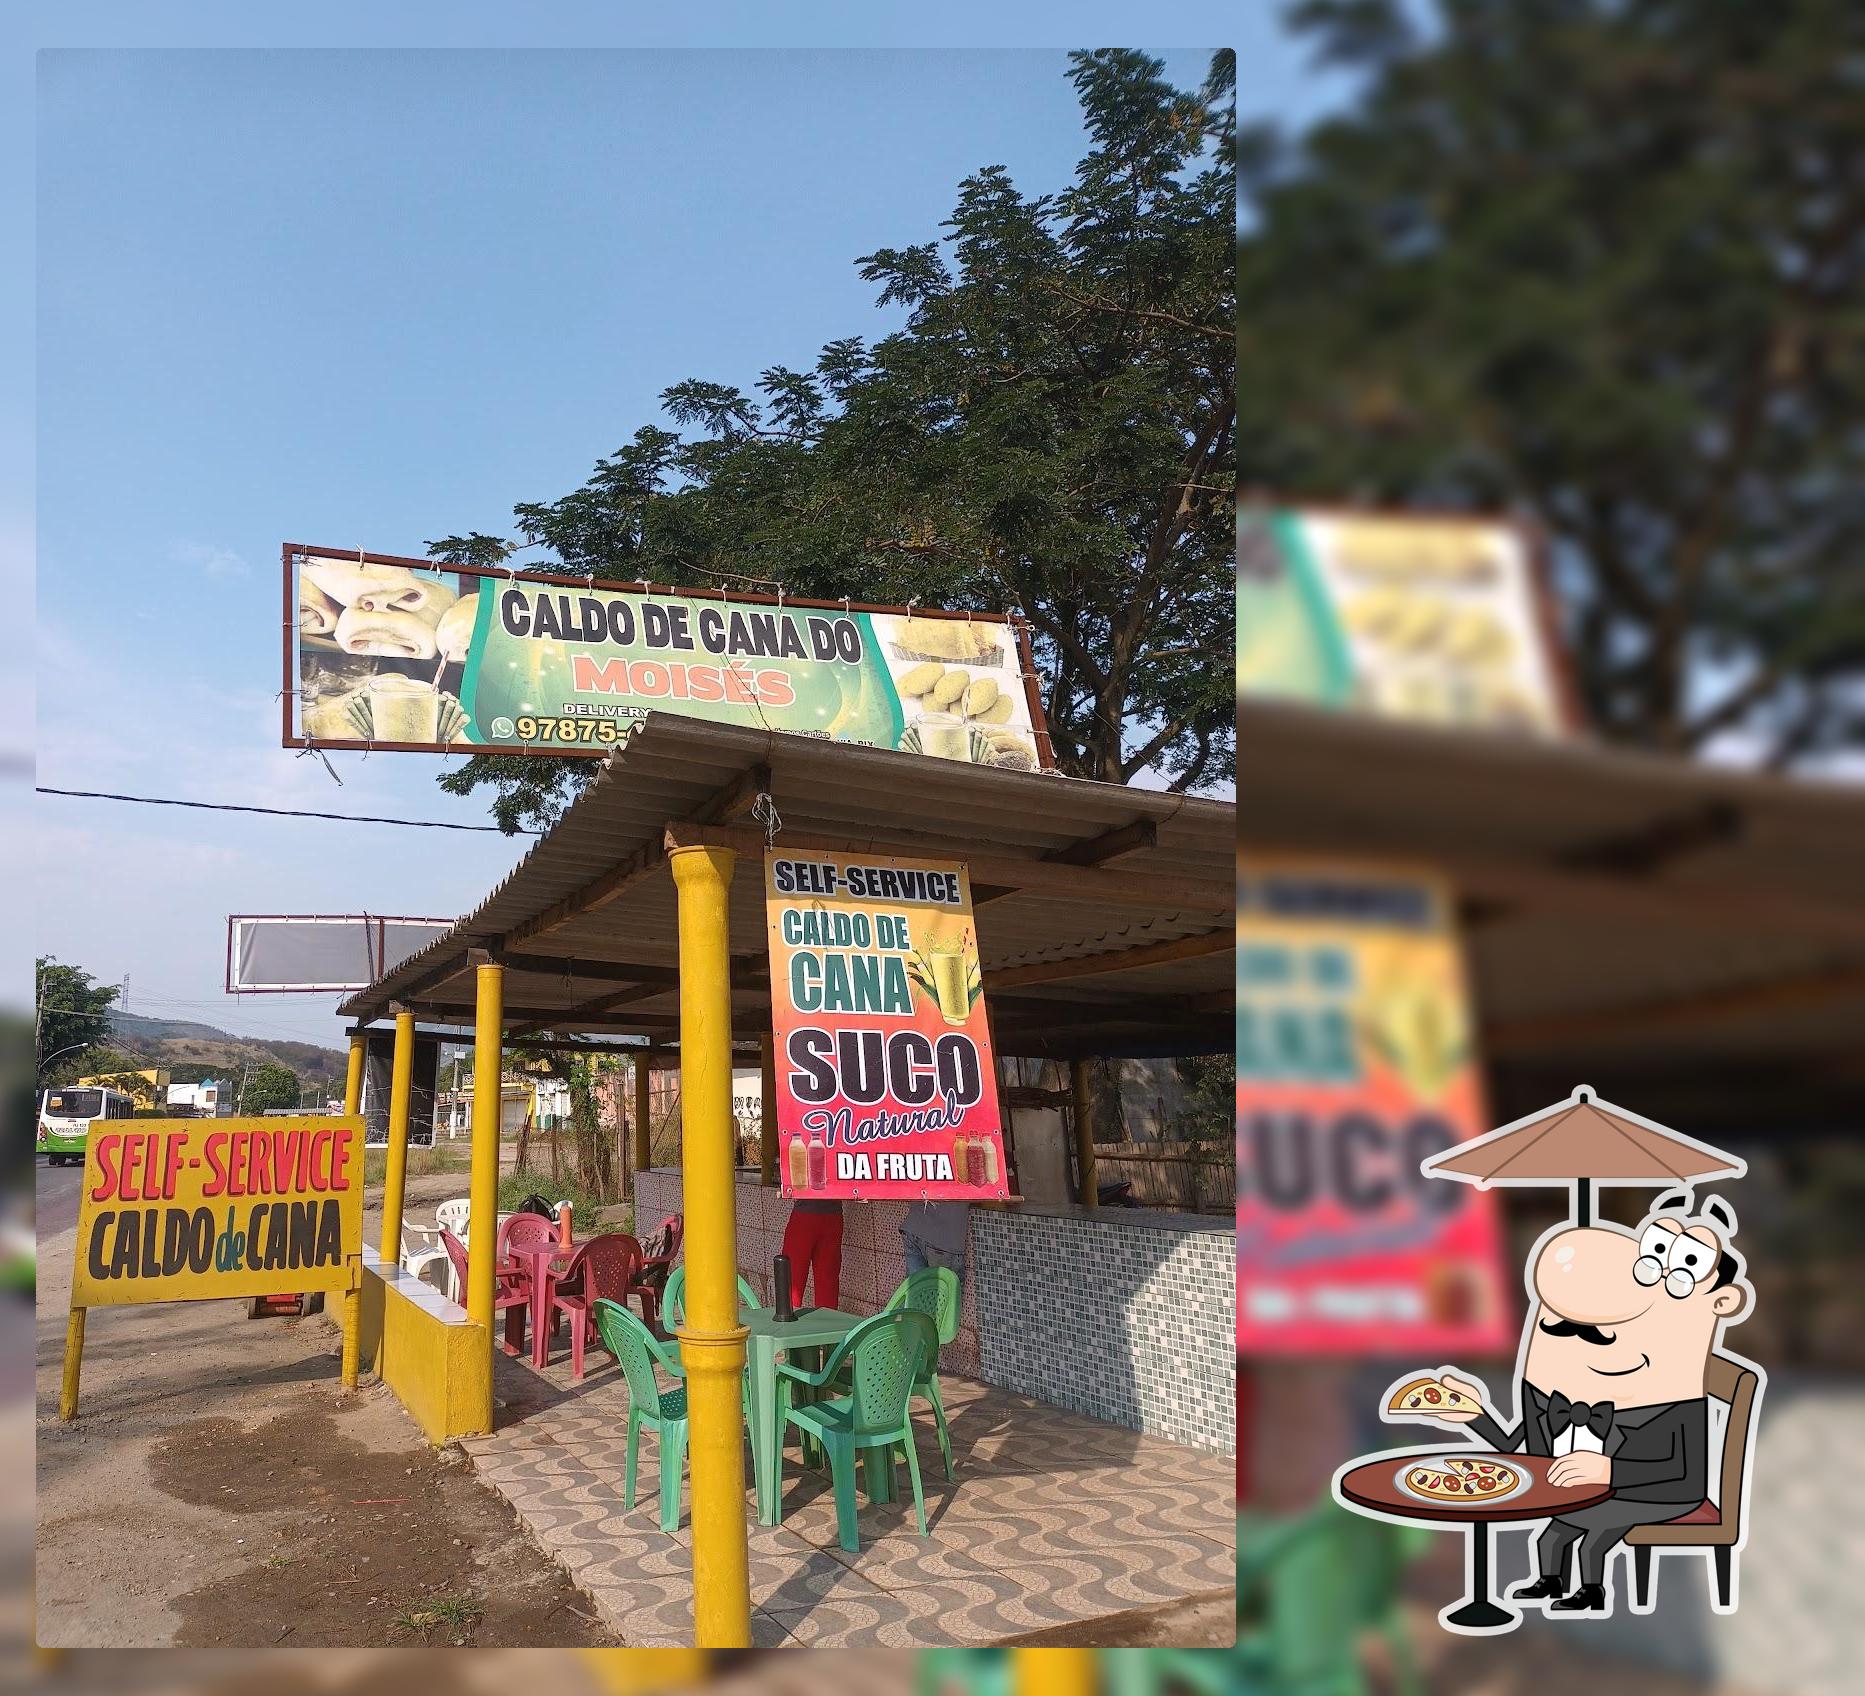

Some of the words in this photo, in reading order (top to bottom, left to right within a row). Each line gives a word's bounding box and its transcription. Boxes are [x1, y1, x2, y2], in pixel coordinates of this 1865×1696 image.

[500, 588, 636, 647] CALDO
[642, 601, 696, 650] DE
[699, 607, 808, 660] CANA
[808, 616, 863, 665] DO
[571, 655, 795, 708] MOISÉS
[516, 716, 644, 744] 97875-
[563, 703, 651, 718] DELIVERY
[774, 859, 961, 905] SELF-SERVICE
[782, 908, 871, 950] CALDO
[874, 911, 911, 952] DE
[789, 951, 916, 1016] CANA
[788, 1026, 983, 1107] SUCO
[803, 1088, 966, 1147] Natural
[91, 1129, 353, 1203] SELF-SERVICE
[836, 1152, 873, 1180] DA
[877, 1152, 954, 1181] FRUTA
[88, 1207, 215, 1280] CALDO
[215, 1206, 245, 1273] de
[246, 1199, 342, 1271] CANA
